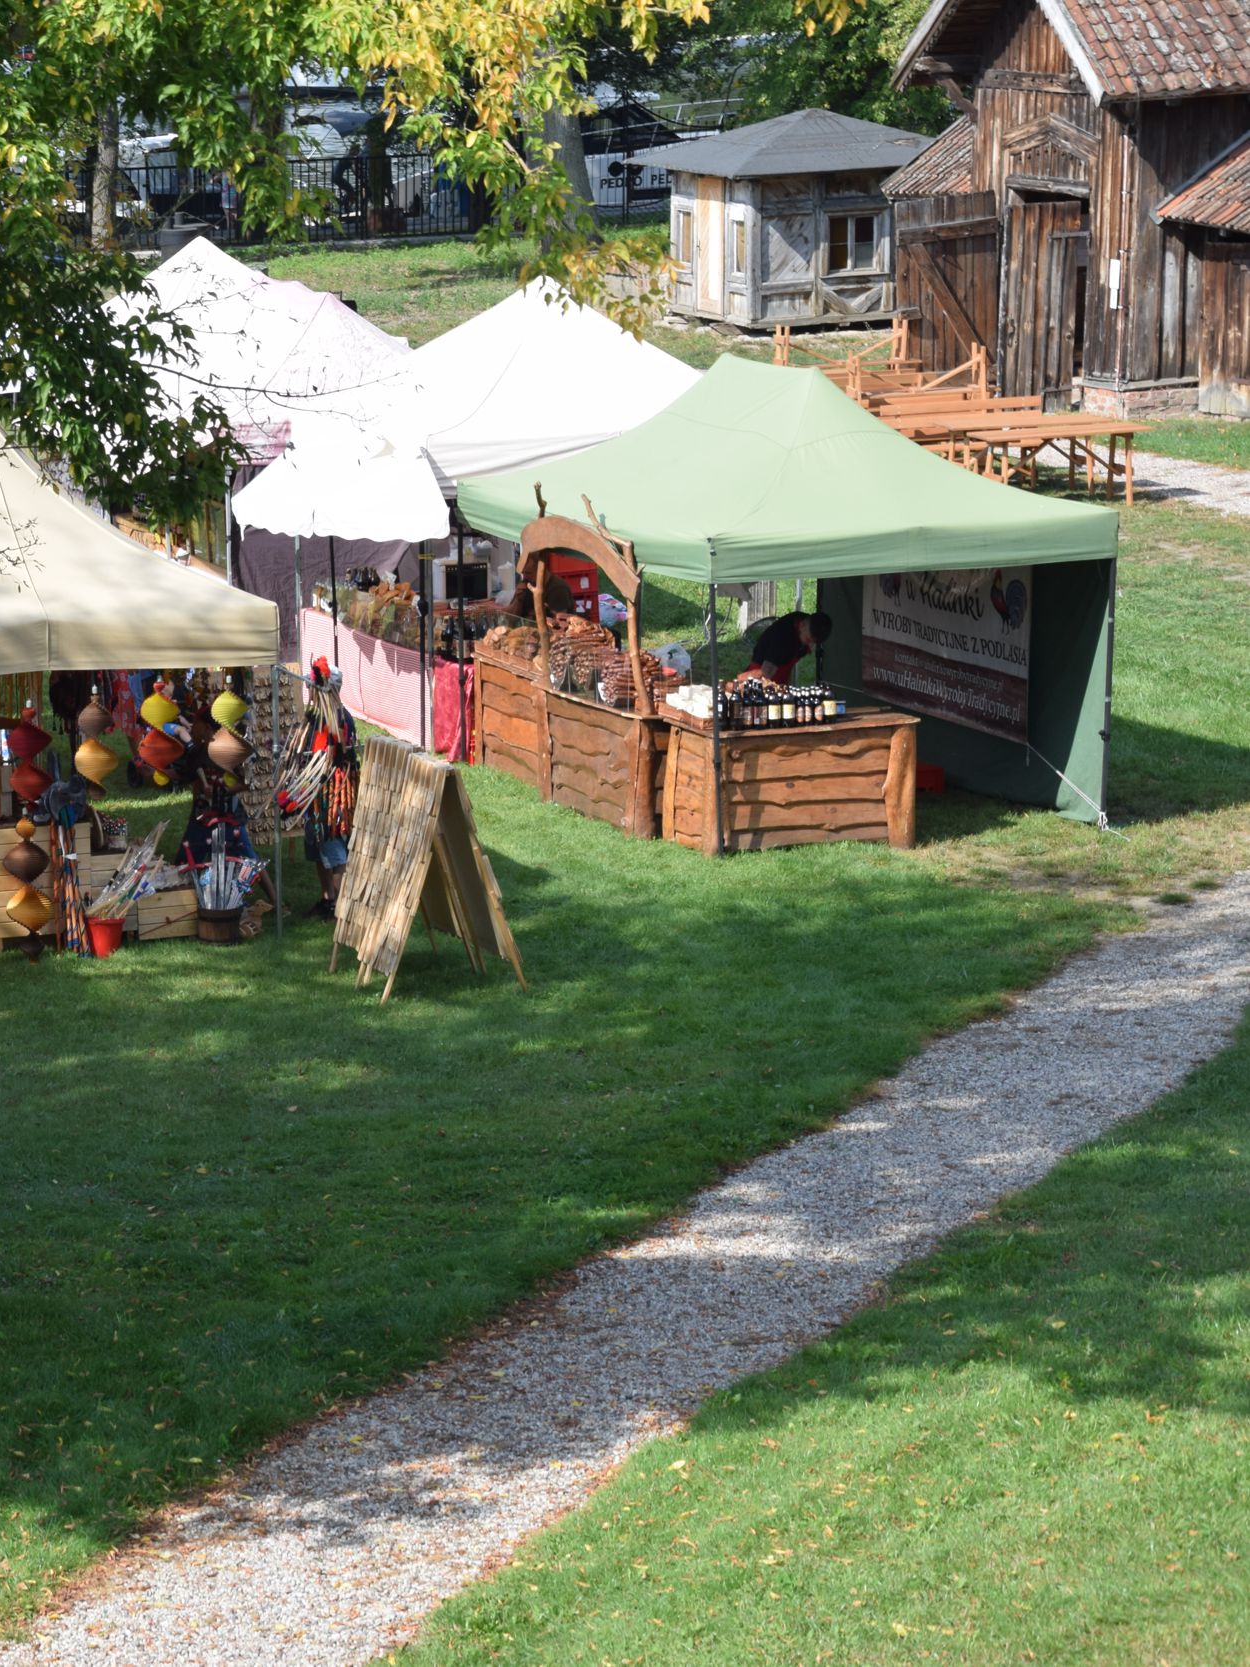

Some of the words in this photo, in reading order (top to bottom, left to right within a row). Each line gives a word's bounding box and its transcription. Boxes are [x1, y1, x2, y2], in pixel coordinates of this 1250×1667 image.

[600, 175, 643, 189] PEDO
[920, 571, 985, 621] Halinki
[872, 609, 912, 634] WYROBY
[914, 620, 969, 652] TRADYCYJNE
[971, 636, 980, 654] Z
[981, 638, 1027, 667] PODLASIA
[872, 665, 1022, 723] www.uHalinkiWyrobyTradycyjne.pl
